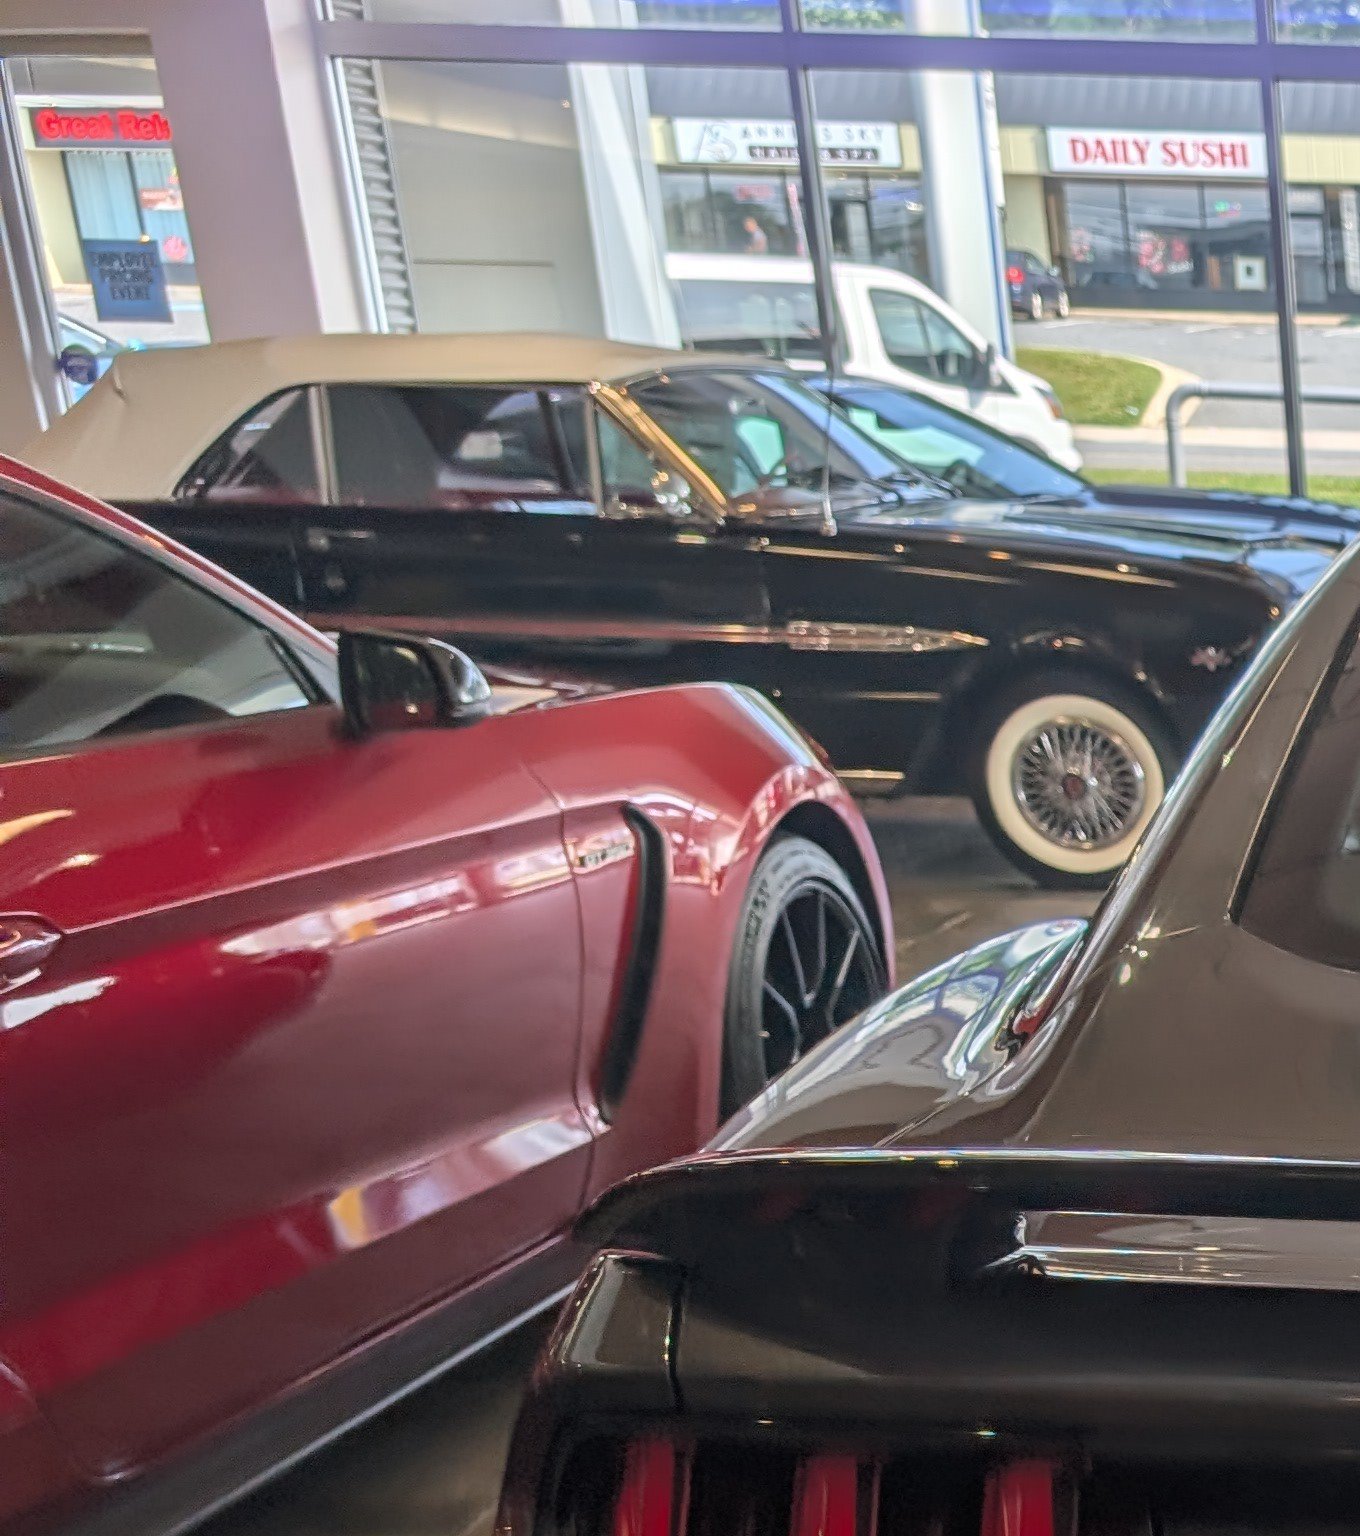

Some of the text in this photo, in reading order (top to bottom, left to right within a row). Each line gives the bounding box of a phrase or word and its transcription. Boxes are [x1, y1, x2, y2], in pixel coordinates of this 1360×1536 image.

[36, 109, 115, 140] Great
[1069, 138, 1249, 168] DAILY SUSHI
